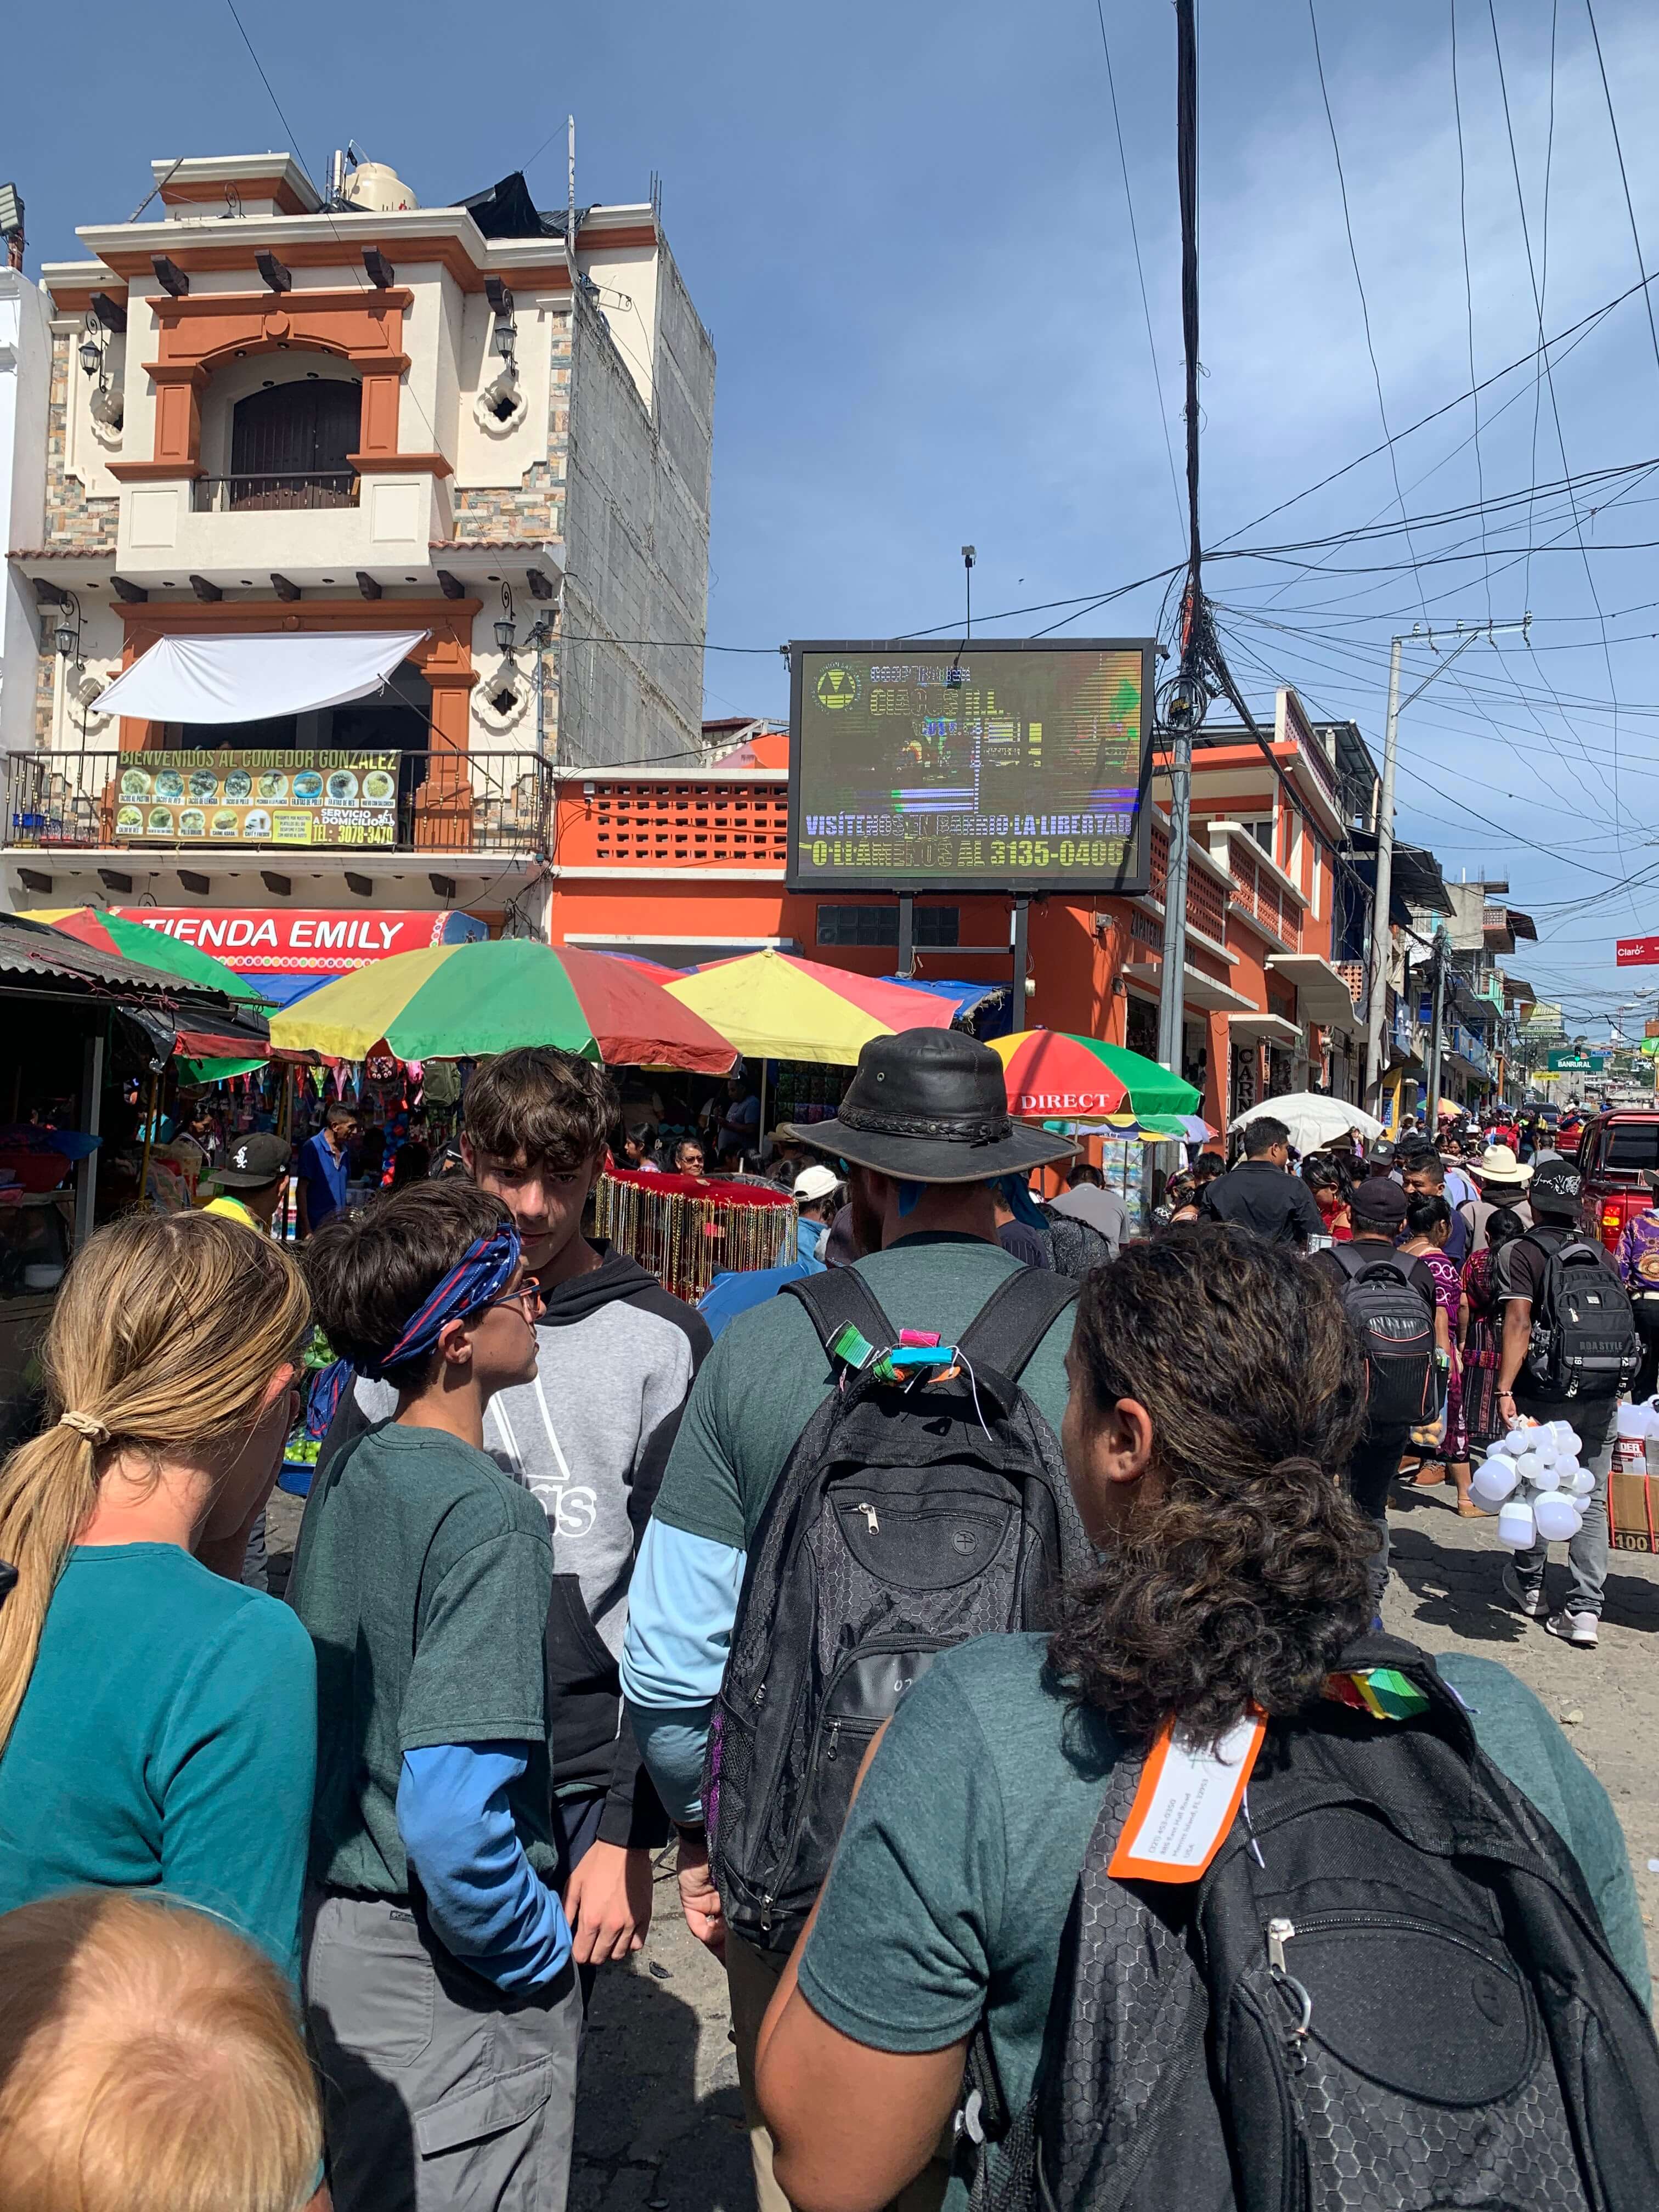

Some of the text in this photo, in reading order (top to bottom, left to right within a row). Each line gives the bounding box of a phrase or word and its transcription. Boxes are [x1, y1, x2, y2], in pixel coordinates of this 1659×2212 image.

[120, 751, 216, 767] BIENVENIDOS
[219, 751, 238, 768] AL
[242, 750, 314, 769] COMEDOR
[321, 809, 371, 818] SERVICIO
[322, 817, 379, 826] DOMICILIO
[1014, 814, 1036, 835] LA
[1041, 814, 1132, 836] LIBERTAD
[289, 920, 404, 950] EMILY
[1617, 948, 1640, 956] Claro
[1021, 1094, 1110, 1109] DIRECT
[1615, 1534, 1648, 1551] 100
[1184, 1843, 1195, 1859] USA
